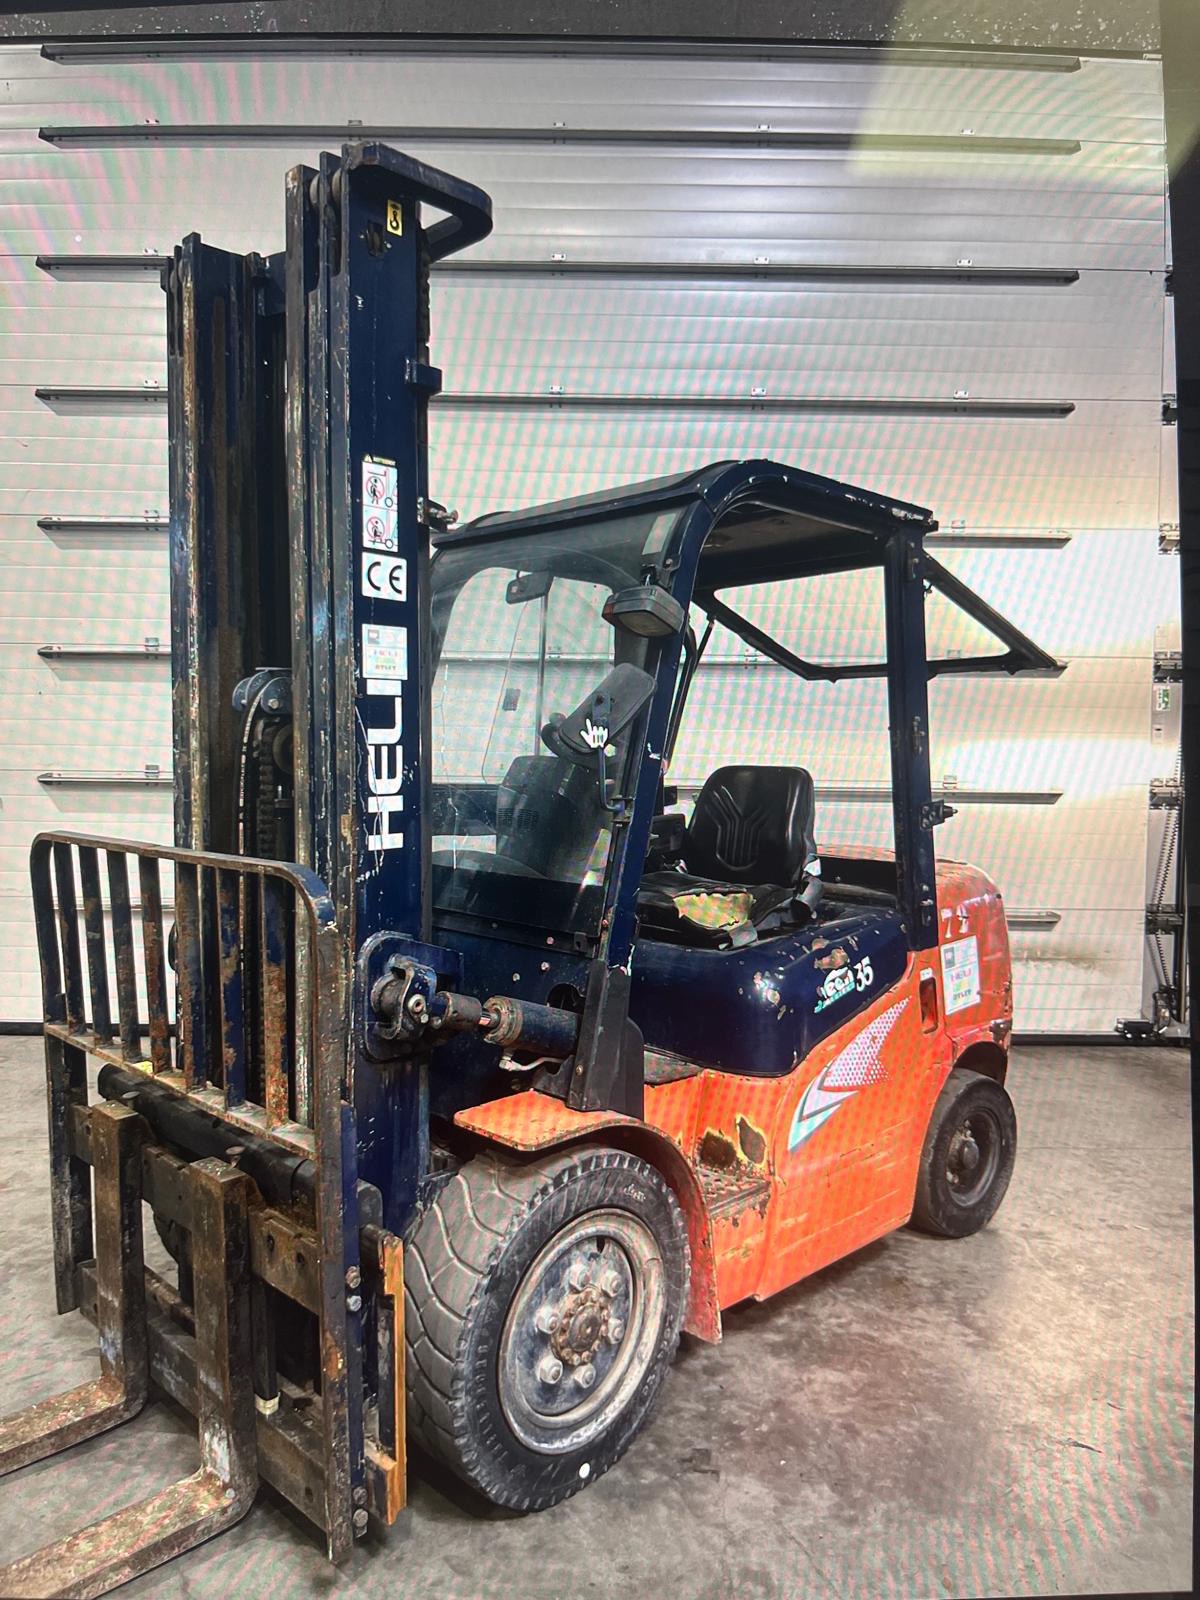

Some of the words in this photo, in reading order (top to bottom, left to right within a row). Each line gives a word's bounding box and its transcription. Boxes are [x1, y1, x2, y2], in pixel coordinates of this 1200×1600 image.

[367, 561, 403, 595] CE
[366, 679, 404, 852] HELI
[853, 956, 874, 992] 35
